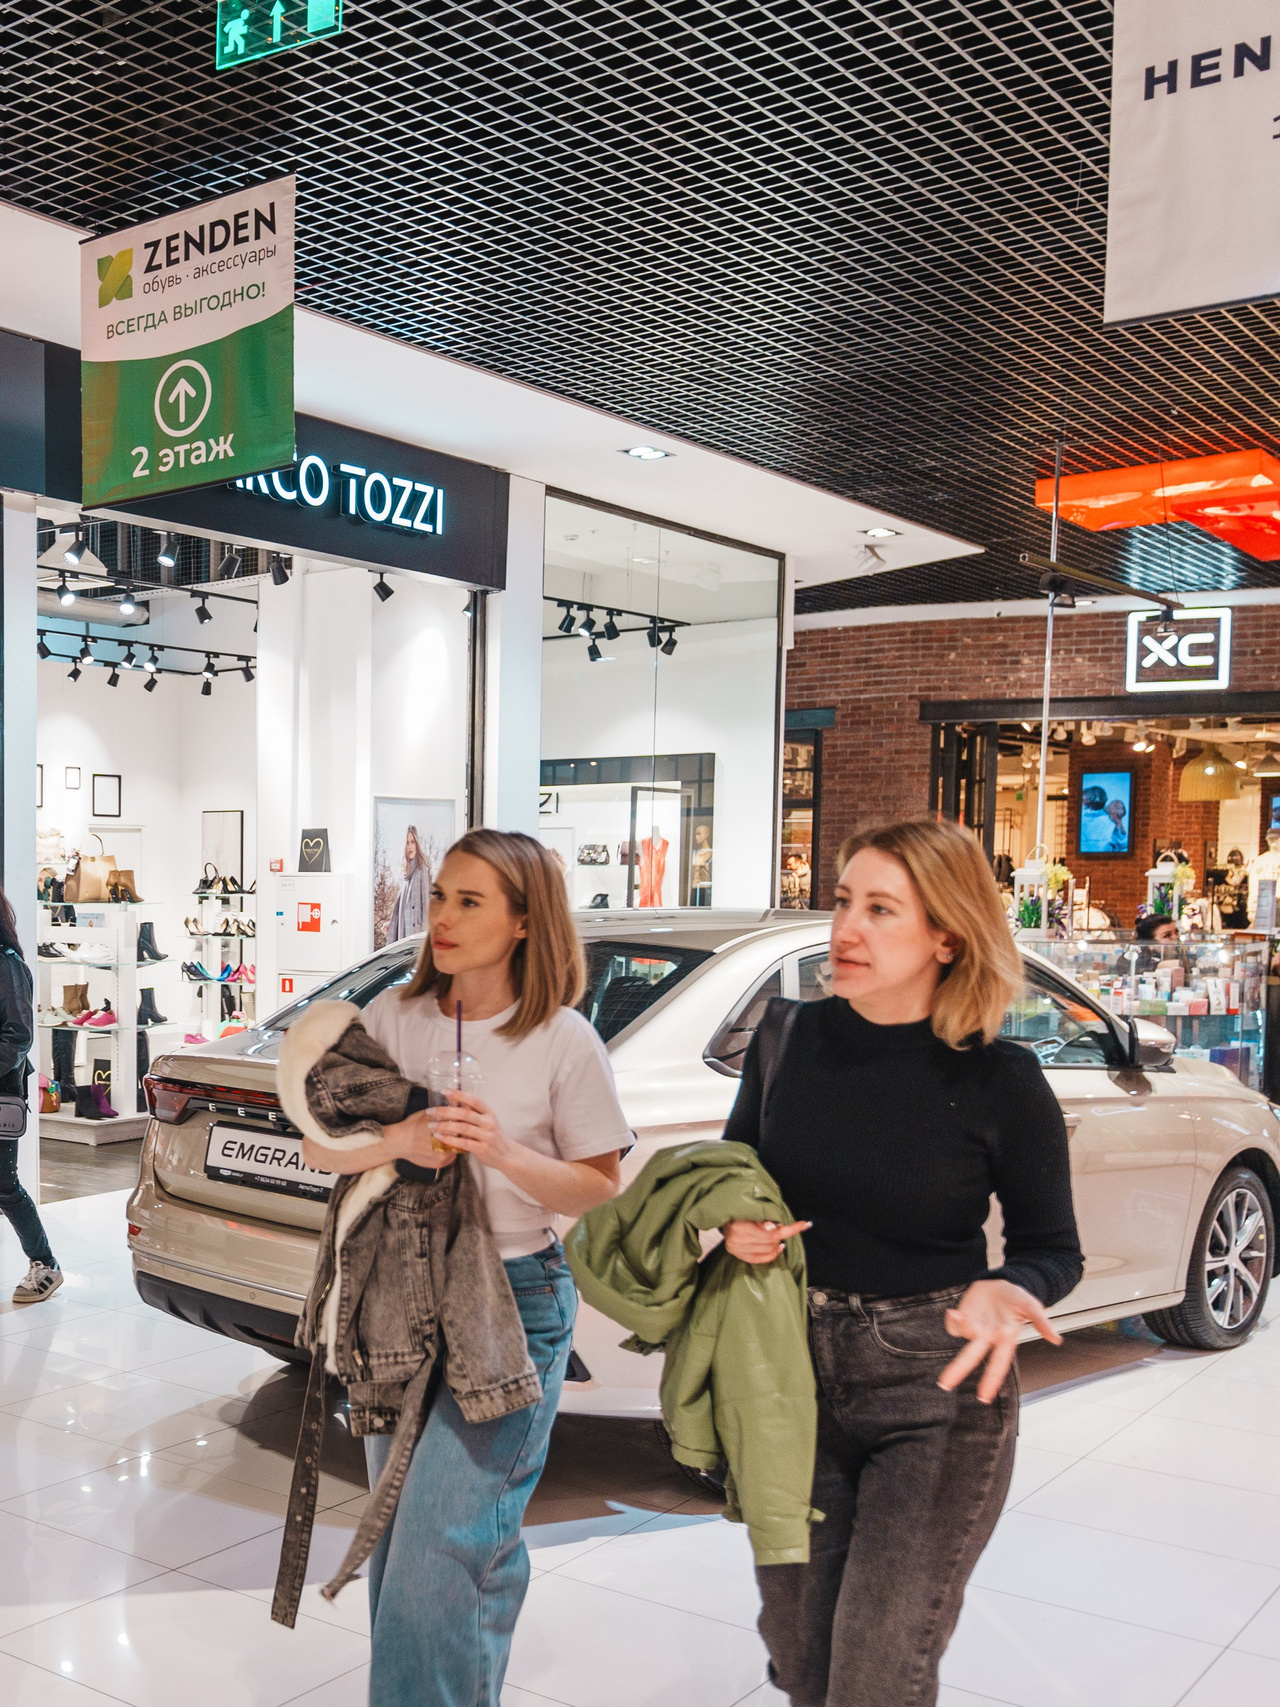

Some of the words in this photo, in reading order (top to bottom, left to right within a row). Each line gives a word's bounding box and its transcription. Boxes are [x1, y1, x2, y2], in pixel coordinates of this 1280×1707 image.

[1144, 35, 1271, 101] HEN
[143, 201, 276, 274] ZENDEN
[143, 274, 182, 295] обувь
[193, 244, 277, 280] аксессуары
[106, 310, 168, 340] ВСЕГДА
[173, 281, 266, 321] ВЫГОДНО!
[131, 445, 150, 478] 2
[157, 433, 235, 473] этаж
[339, 463, 444, 535] TOZZI
[1141, 632, 1215, 668] XC
[222, 1140, 332, 1175] EMGRA
